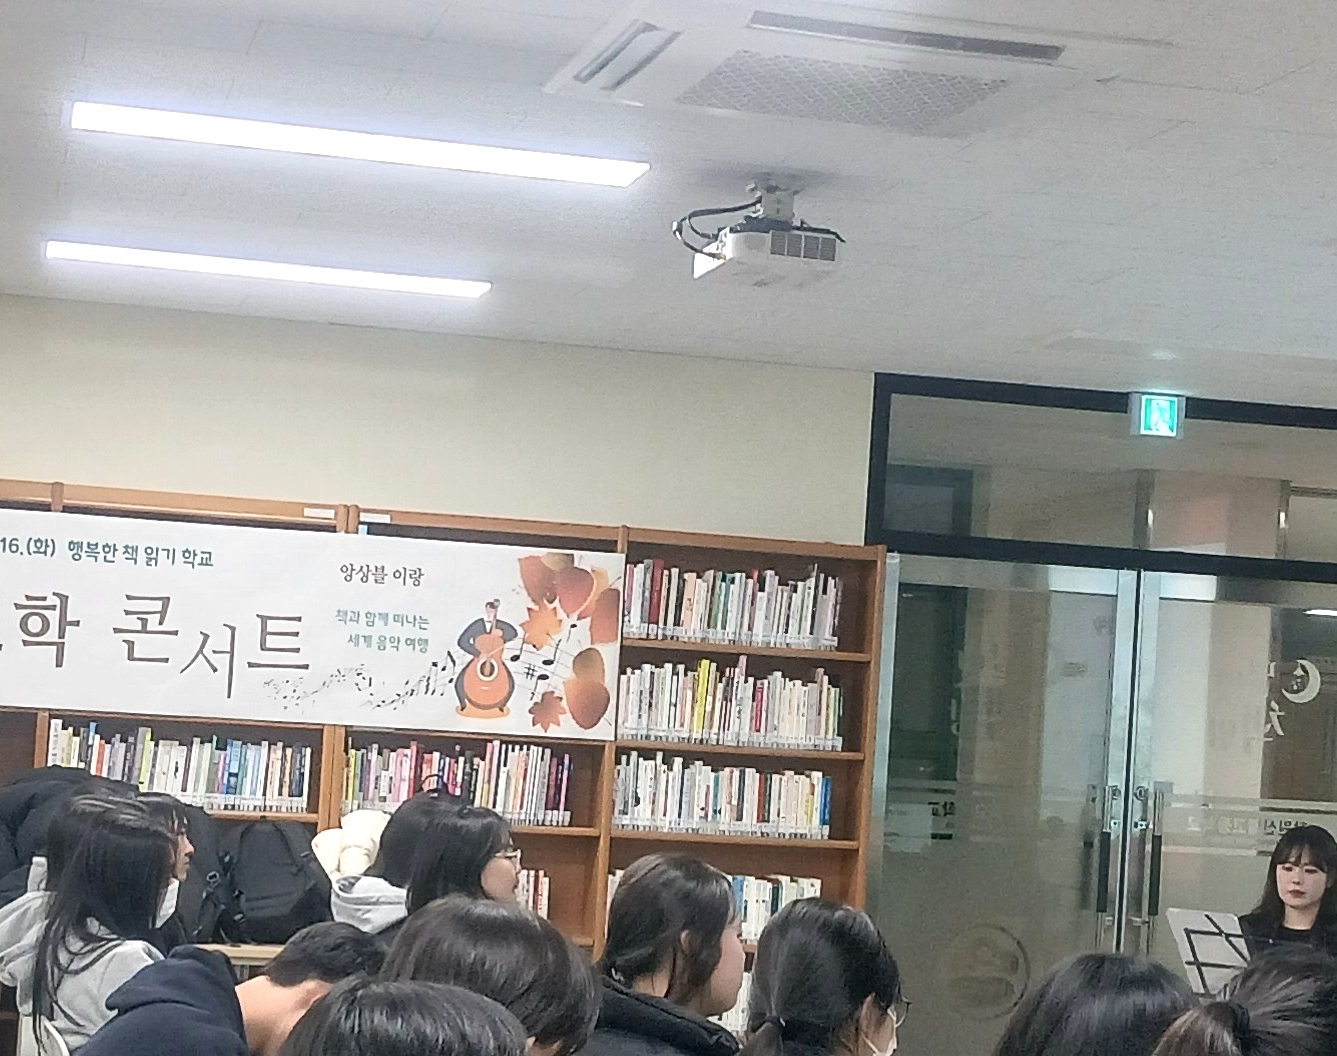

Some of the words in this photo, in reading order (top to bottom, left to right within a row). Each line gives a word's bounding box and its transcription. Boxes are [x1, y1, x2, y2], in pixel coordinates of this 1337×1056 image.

[68, 540, 118, 564] 행복한
[122, 544, 139, 565] 책
[143, 545, 176, 567] 읽기
[181, 547, 214, 569] 학교
[340, 563, 388, 584] 앙상블
[393, 566, 425, 587] 이랑
[335, 609, 360, 625] 책과
[365, 611, 389, 627] 함께
[112, 594, 310, 699] 콘서트
[347, 633, 373, 648] 세계
[376, 635, 401, 651] 음악
[405, 637, 429, 654] 여행
